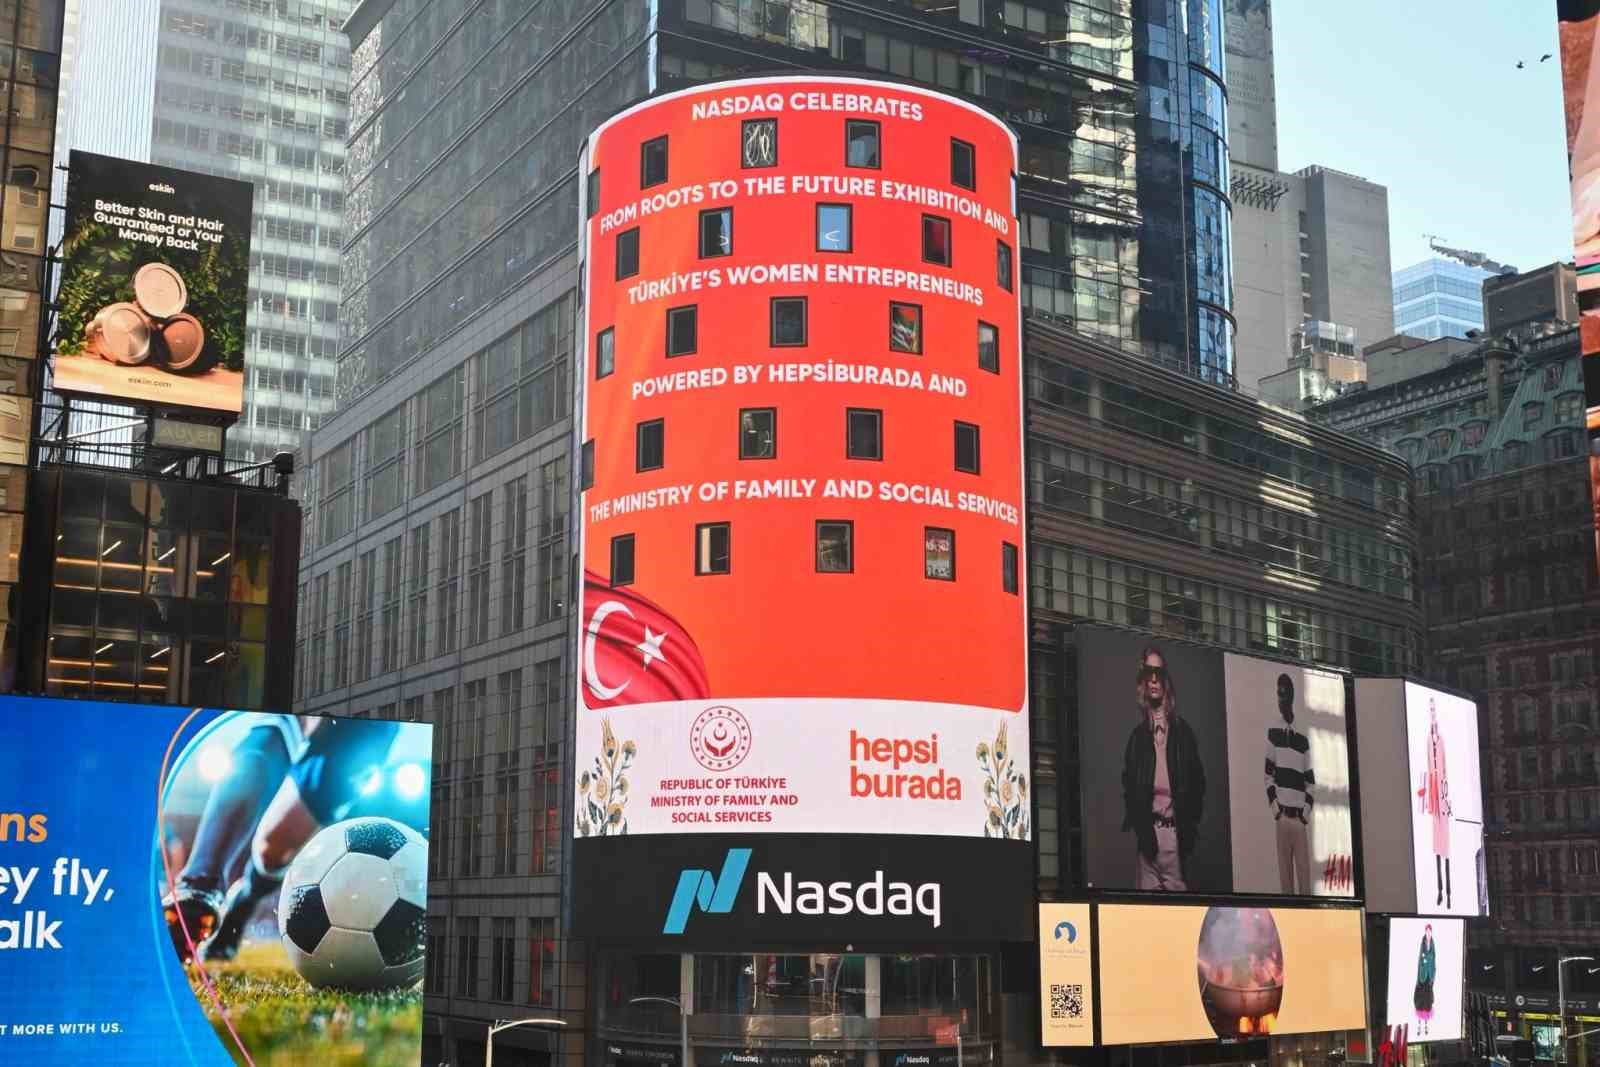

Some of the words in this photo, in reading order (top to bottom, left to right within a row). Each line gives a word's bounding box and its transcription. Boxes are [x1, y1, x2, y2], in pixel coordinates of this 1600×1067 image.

[691, 93, 784, 121] NASDAQ
[790, 92, 924, 122] CELEBRATES
[95, 199, 135, 216] Better
[138, 207, 166, 222] Skin
[168, 215, 195, 227] and
[198, 218, 225, 232] Hair
[600, 207, 638, 236] FROM
[641, 183, 704, 214] ROOTS
[709, 179, 739, 200] TO
[744, 177, 786, 196] THE
[792, 175, 876, 197] FUTURE
[881, 180, 982, 218] EXHIBITION
[984, 209, 1009, 235] AND
[94, 211, 175, 235] Guaranteed
[177, 227, 192, 238] or
[194, 228, 225, 243] Your
[119, 227, 164, 248] Money
[166, 236, 199, 252] Back
[727, 264, 819, 286] WOMEN
[825, 264, 984, 306] ENTREPRENEURS
[632, 367, 728, 400] POWERED
[733, 364, 763, 385] BY
[928, 375, 968, 398] AND
[590, 501, 613, 523] THE
[613, 485, 693, 516] MINISTRY
[698, 481, 729, 502] OF
[734, 478, 817, 499] FAMILY
[823, 480, 874, 500] AND
[879, 482, 954, 509] SOCIAL
[957, 493, 1019, 526] SERVICES
[850, 730, 938, 770] hepsi
[660, 779, 713, 790] REPUBLIC
[716, 778, 732, 788] OF
[735, 776, 787, 789] TÜRKİYE
[850, 766, 962, 801] burada
[650, 796, 702, 808] MINISTRY
[704, 797, 720, 807] OF
[723, 796, 767, 806] FAMILY
[770, 794, 799, 805] AND
[671, 811, 711, 824] SOCIAL
[714, 812, 772, 823] SERVICES
[52, 856, 115, 906] fly,
[757, 871, 941, 928] Nasdaq
[12, 1023, 55, 1036] MORE
[59, 1022, 96, 1035] WITH
[101, 1021, 124, 1034] US.
